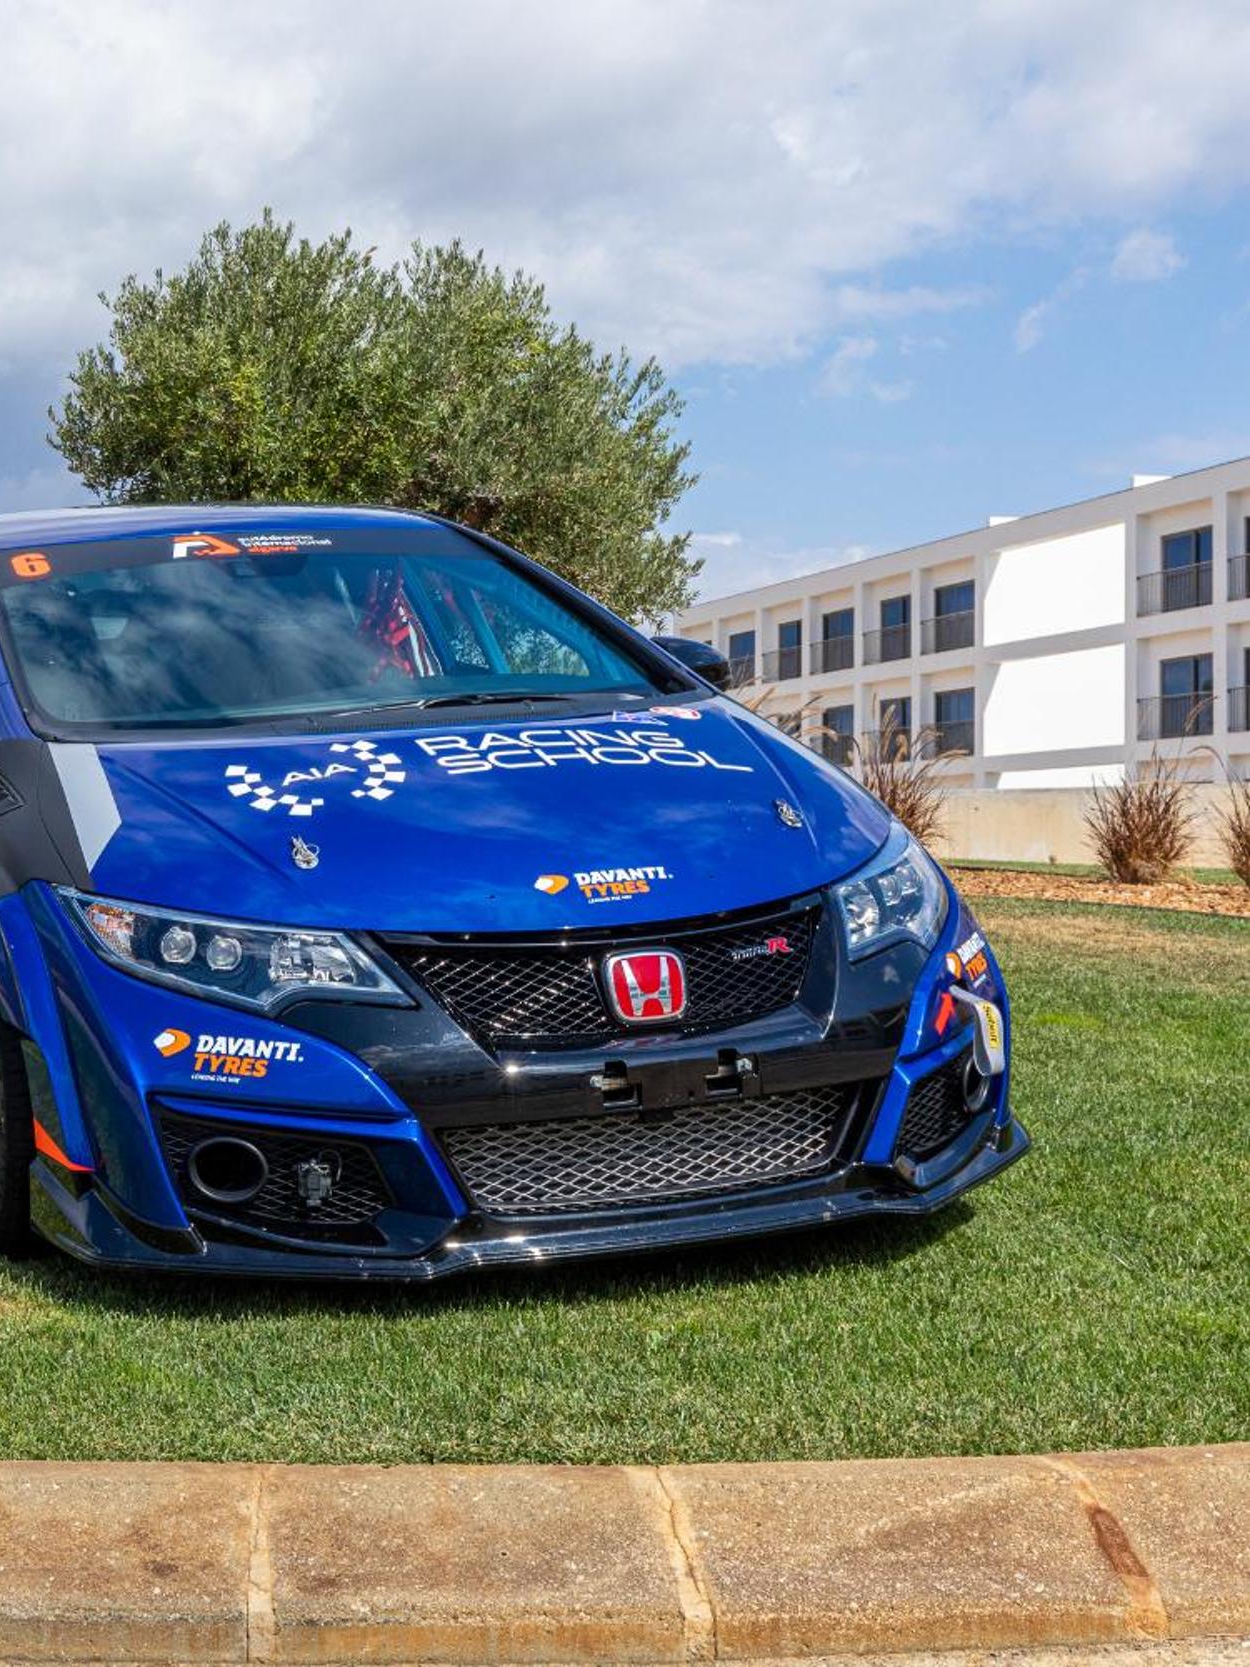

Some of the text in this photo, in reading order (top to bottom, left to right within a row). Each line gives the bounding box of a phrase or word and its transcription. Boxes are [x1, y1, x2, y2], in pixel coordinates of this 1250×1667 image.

[11, 553, 50, 577] 6
[415, 729, 685, 756] RACING
[437, 746, 754, 774] SCHOOL
[281, 763, 358, 786] AIA
[580, 880, 650, 898] TYRES
[194, 1053, 269, 1077] TYRES
